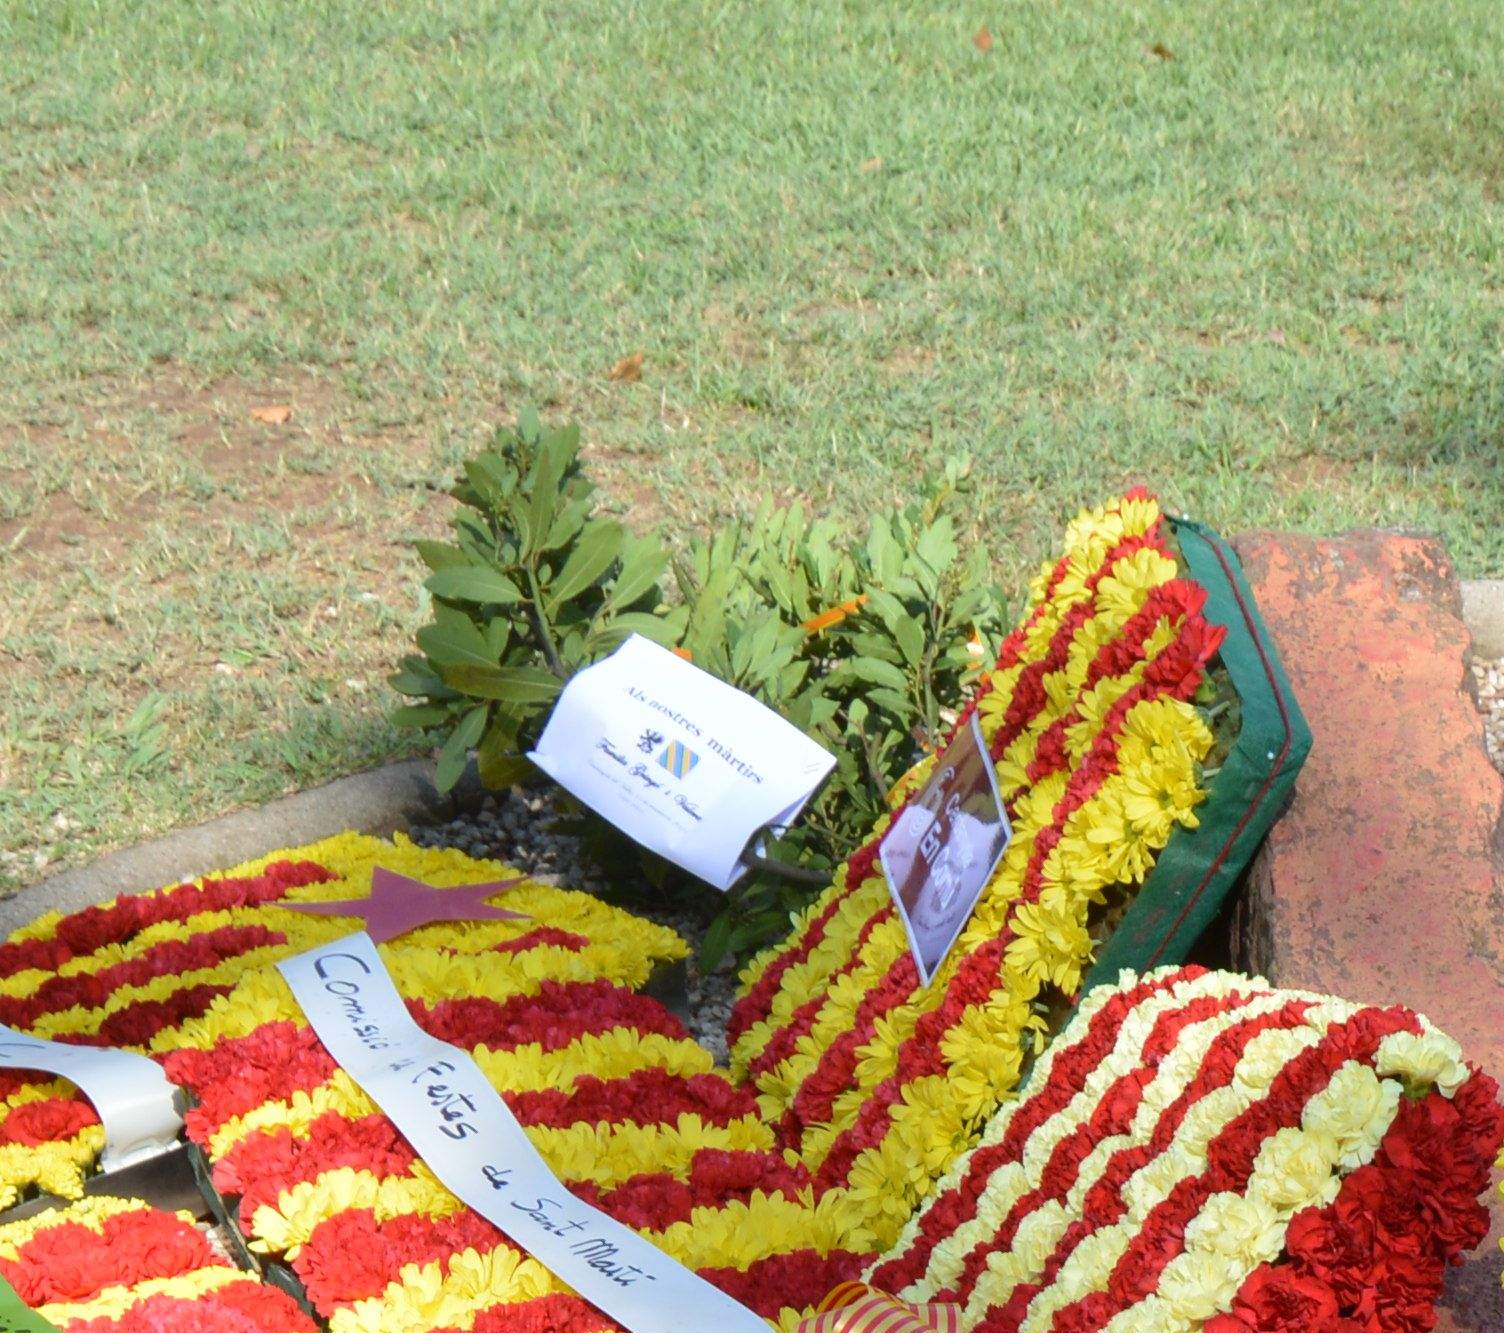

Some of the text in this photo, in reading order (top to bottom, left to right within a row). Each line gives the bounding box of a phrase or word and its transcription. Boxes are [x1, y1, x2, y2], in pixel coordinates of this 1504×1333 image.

[648, 699, 704, 738] nostres
[411, 1061, 479, 1140] Festes
[481, 1165, 513, 1190] de
[510, 1198, 589, 1237] Sant
